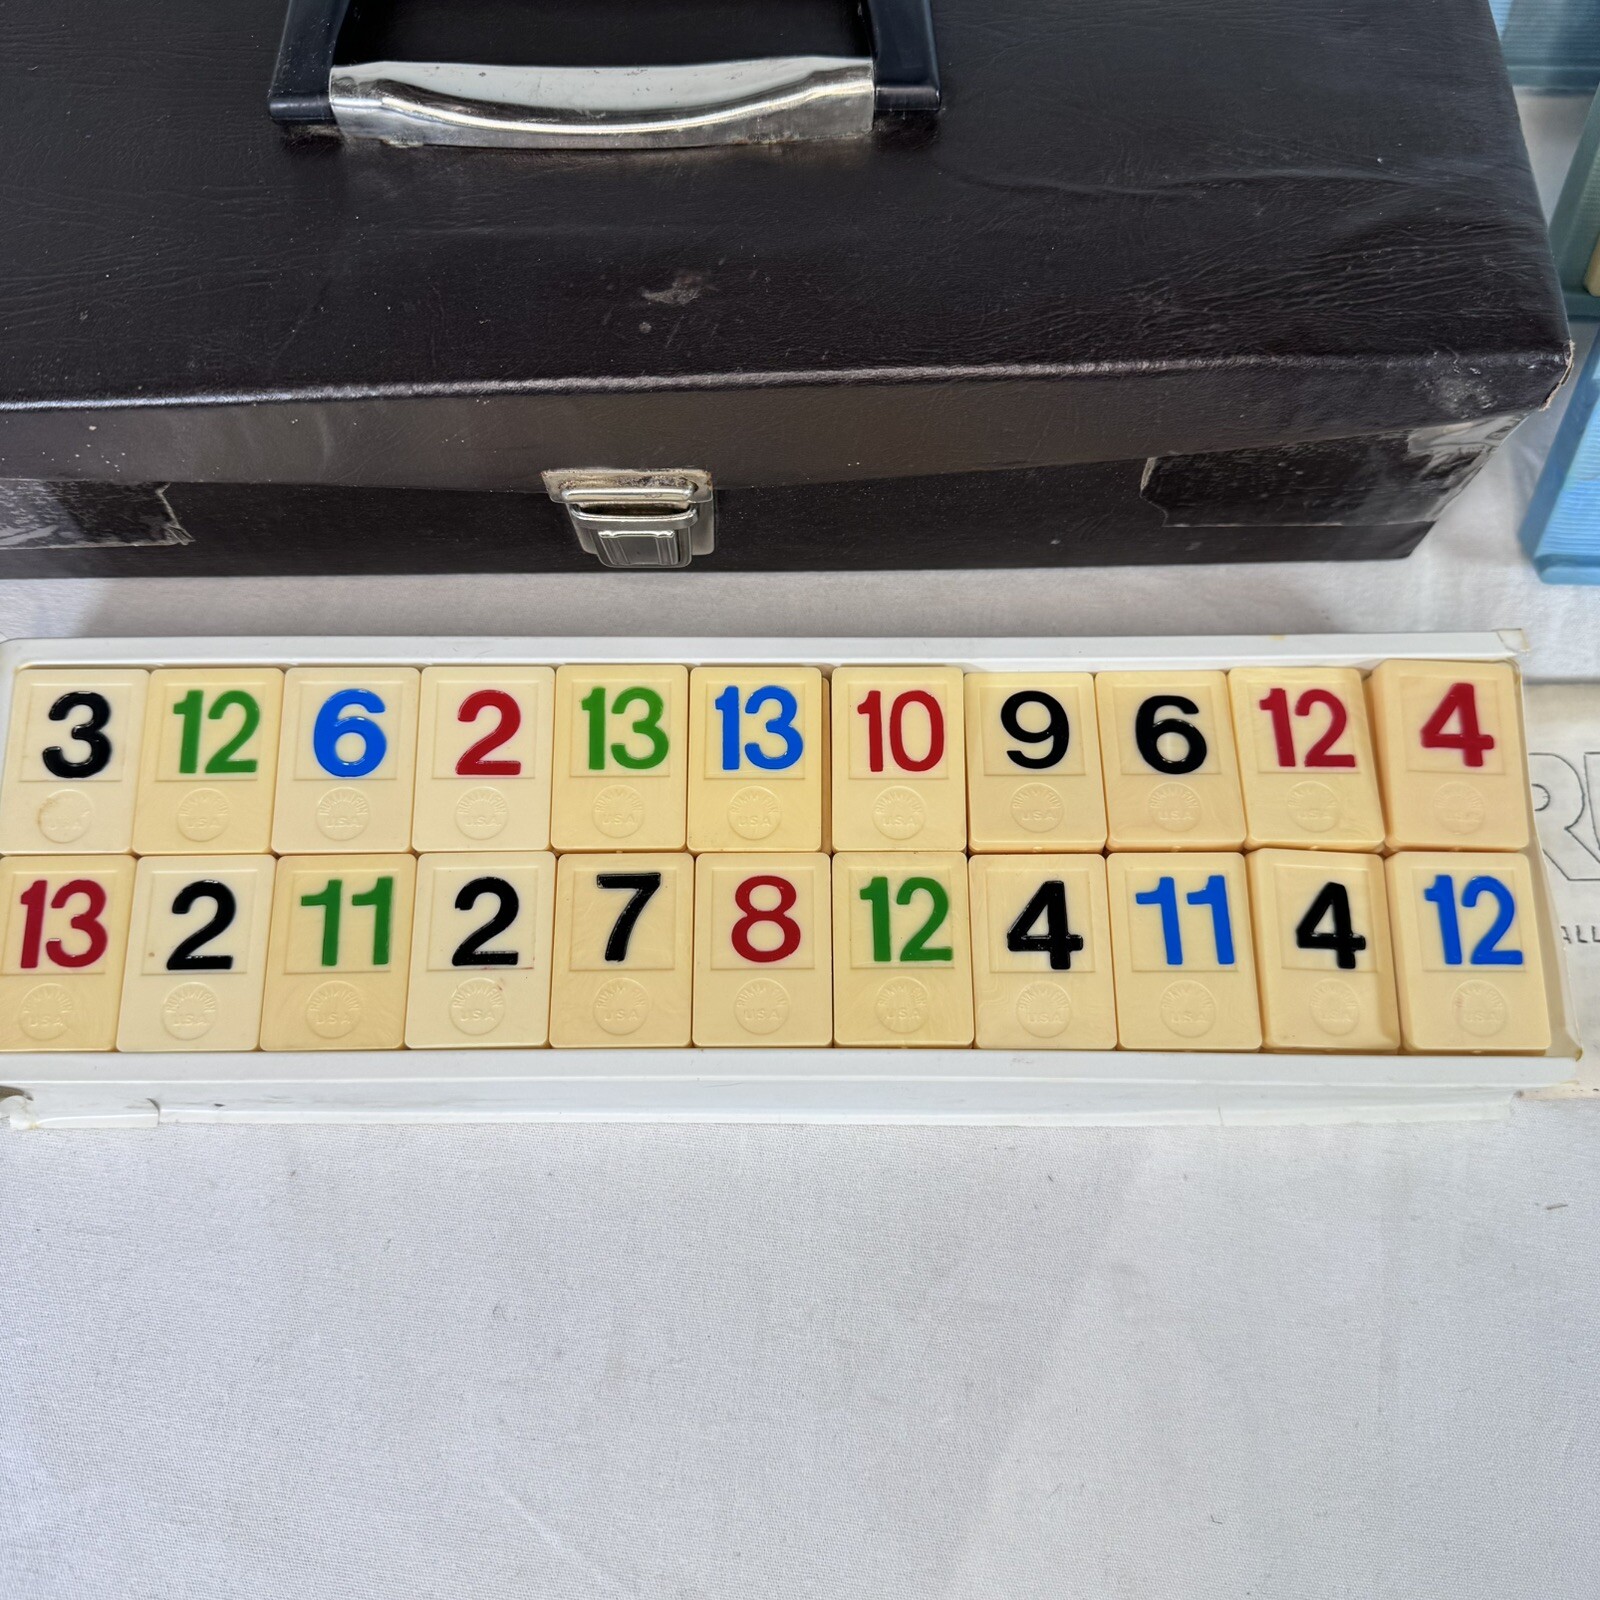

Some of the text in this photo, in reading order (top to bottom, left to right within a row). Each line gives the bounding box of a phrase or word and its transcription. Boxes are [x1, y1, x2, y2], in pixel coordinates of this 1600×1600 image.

[42, 692, 112, 778] 3
[173, 690, 260, 774] 12
[313, 689, 387, 777] 6
[457, 689, 521, 775] 2
[582, 686, 670, 770] 13
[715, 685, 804, 770] 13
[857, 690, 945, 772] 10
[1000, 690, 1070, 770] 9
[1135, 694, 1208, 775] 6
[1259, 688, 1356, 768] 12
[1421, 682, 1495, 768] 4
[20, 879, 108, 968] 13
[166, 879, 237, 971] 2
[300, 877, 393, 967] 11
[452, 876, 520, 967] 2
[596, 871, 662, 963] 7
[731, 875, 801, 963] 8
[859, 876, 953, 963] 12
[1006, 880, 1084, 971] 4
[1135, 875, 1235, 966] 11
[1295, 881, 1367, 970] 4
[1424, 875, 1523, 966] 12
